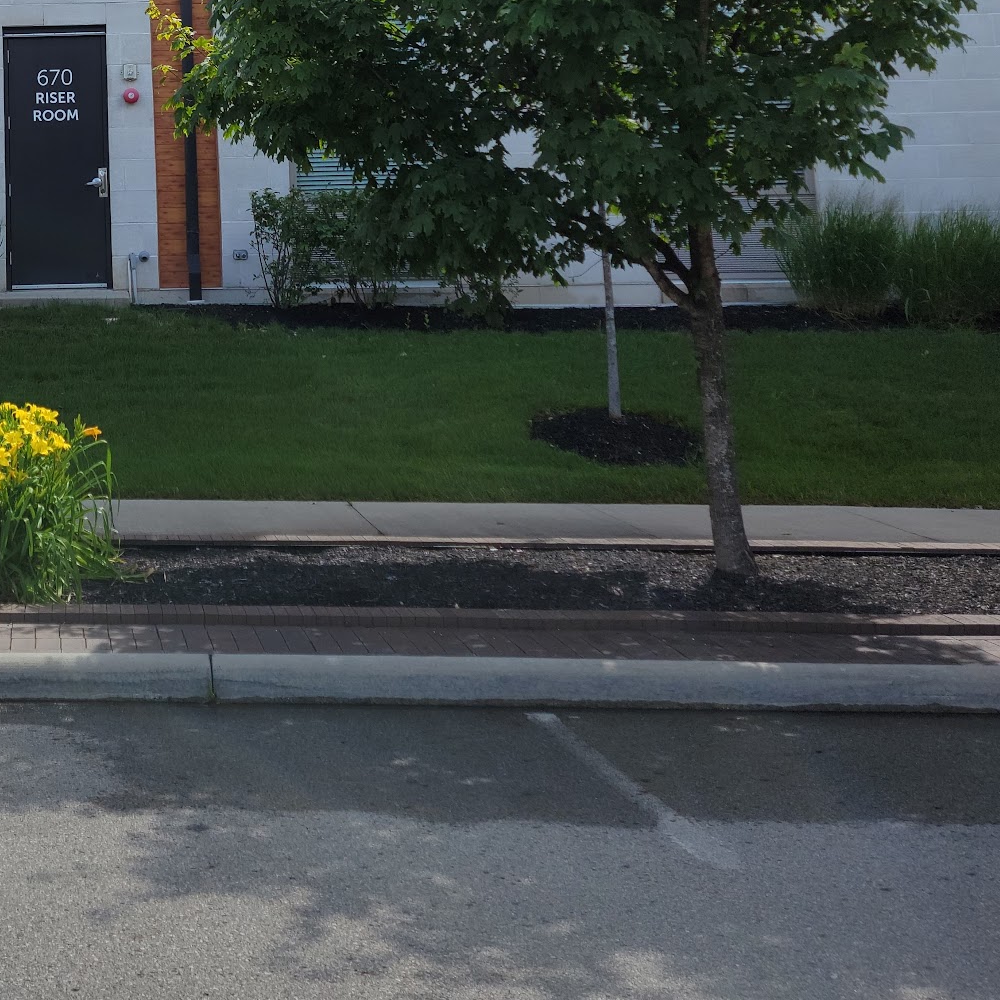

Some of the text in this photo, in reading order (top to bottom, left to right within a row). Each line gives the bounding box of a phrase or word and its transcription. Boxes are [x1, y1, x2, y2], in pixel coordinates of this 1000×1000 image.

[36, 68, 73, 87] 670
[35, 91, 76, 104] RISER
[33, 108, 79, 122] ROOM
